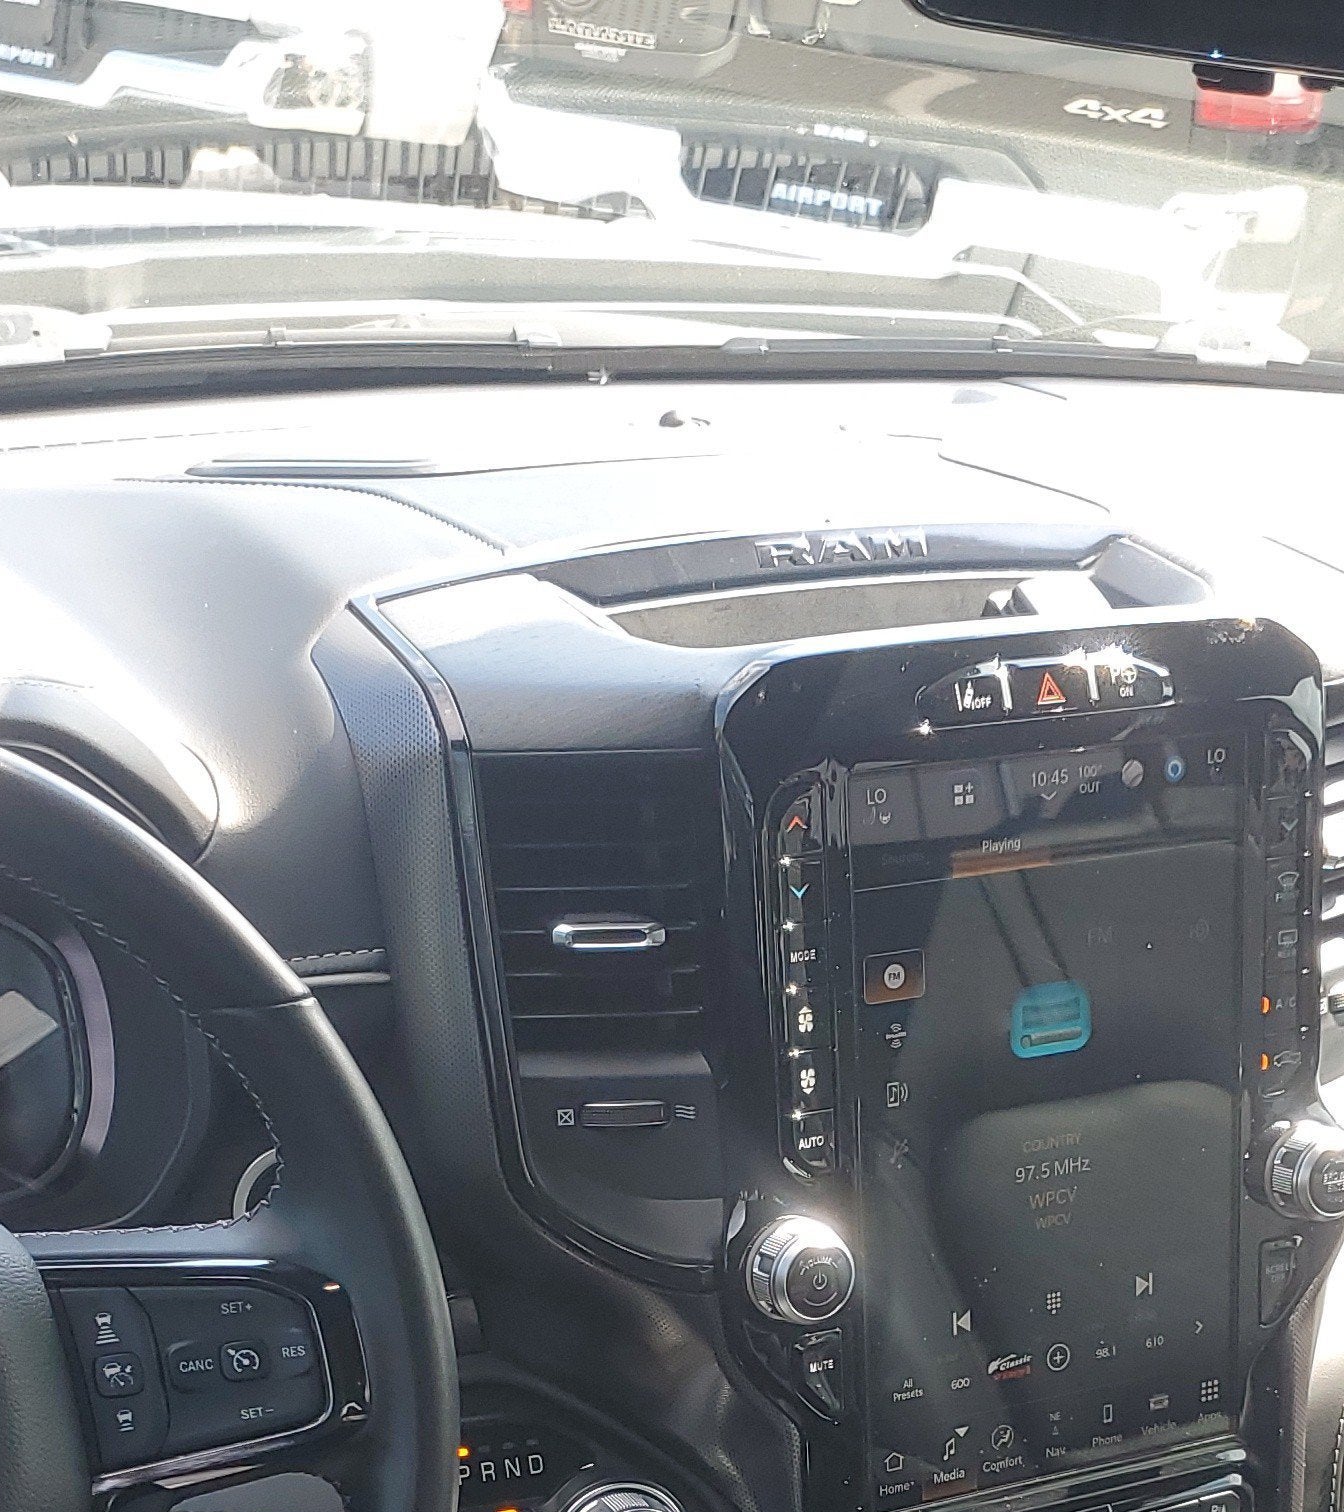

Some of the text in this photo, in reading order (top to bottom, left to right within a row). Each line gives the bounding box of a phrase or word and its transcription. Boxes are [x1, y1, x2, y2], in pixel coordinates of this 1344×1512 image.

[1064, 98, 1169, 129] 4x4
[771, 181, 883, 218] AIRPORT
[755, 527, 928, 568] RAM
[975, 695, 992, 709] OFF
[1206, 747, 1226, 764] LO
[1029, 768, 1069, 788] 10:45
[866, 787, 887, 805] LO
[1078, 780, 1101, 795] OUT
[981, 837, 1022, 855] Playing
[790, 948, 817, 963] MODE
[797, 1135, 824, 1151] AUTO
[1015, 1157, 1092, 1183] 97.5 MHz
[281, 1345, 306, 1358] RES
[178, 1358, 215, 1373] CANC
[809, 1359, 834, 1373] MUTE
[951, 1377, 971, 1390] 600
[893, 1388, 924, 1402] Presets
[1091, 1433, 1124, 1448] Phone
[458, 1454, 544, 1486] P R N D
[982, 1454, 1023, 1473] Comfort
[933, 1468, 966, 1485] Media
[879, 1481, 911, 1498] Home
